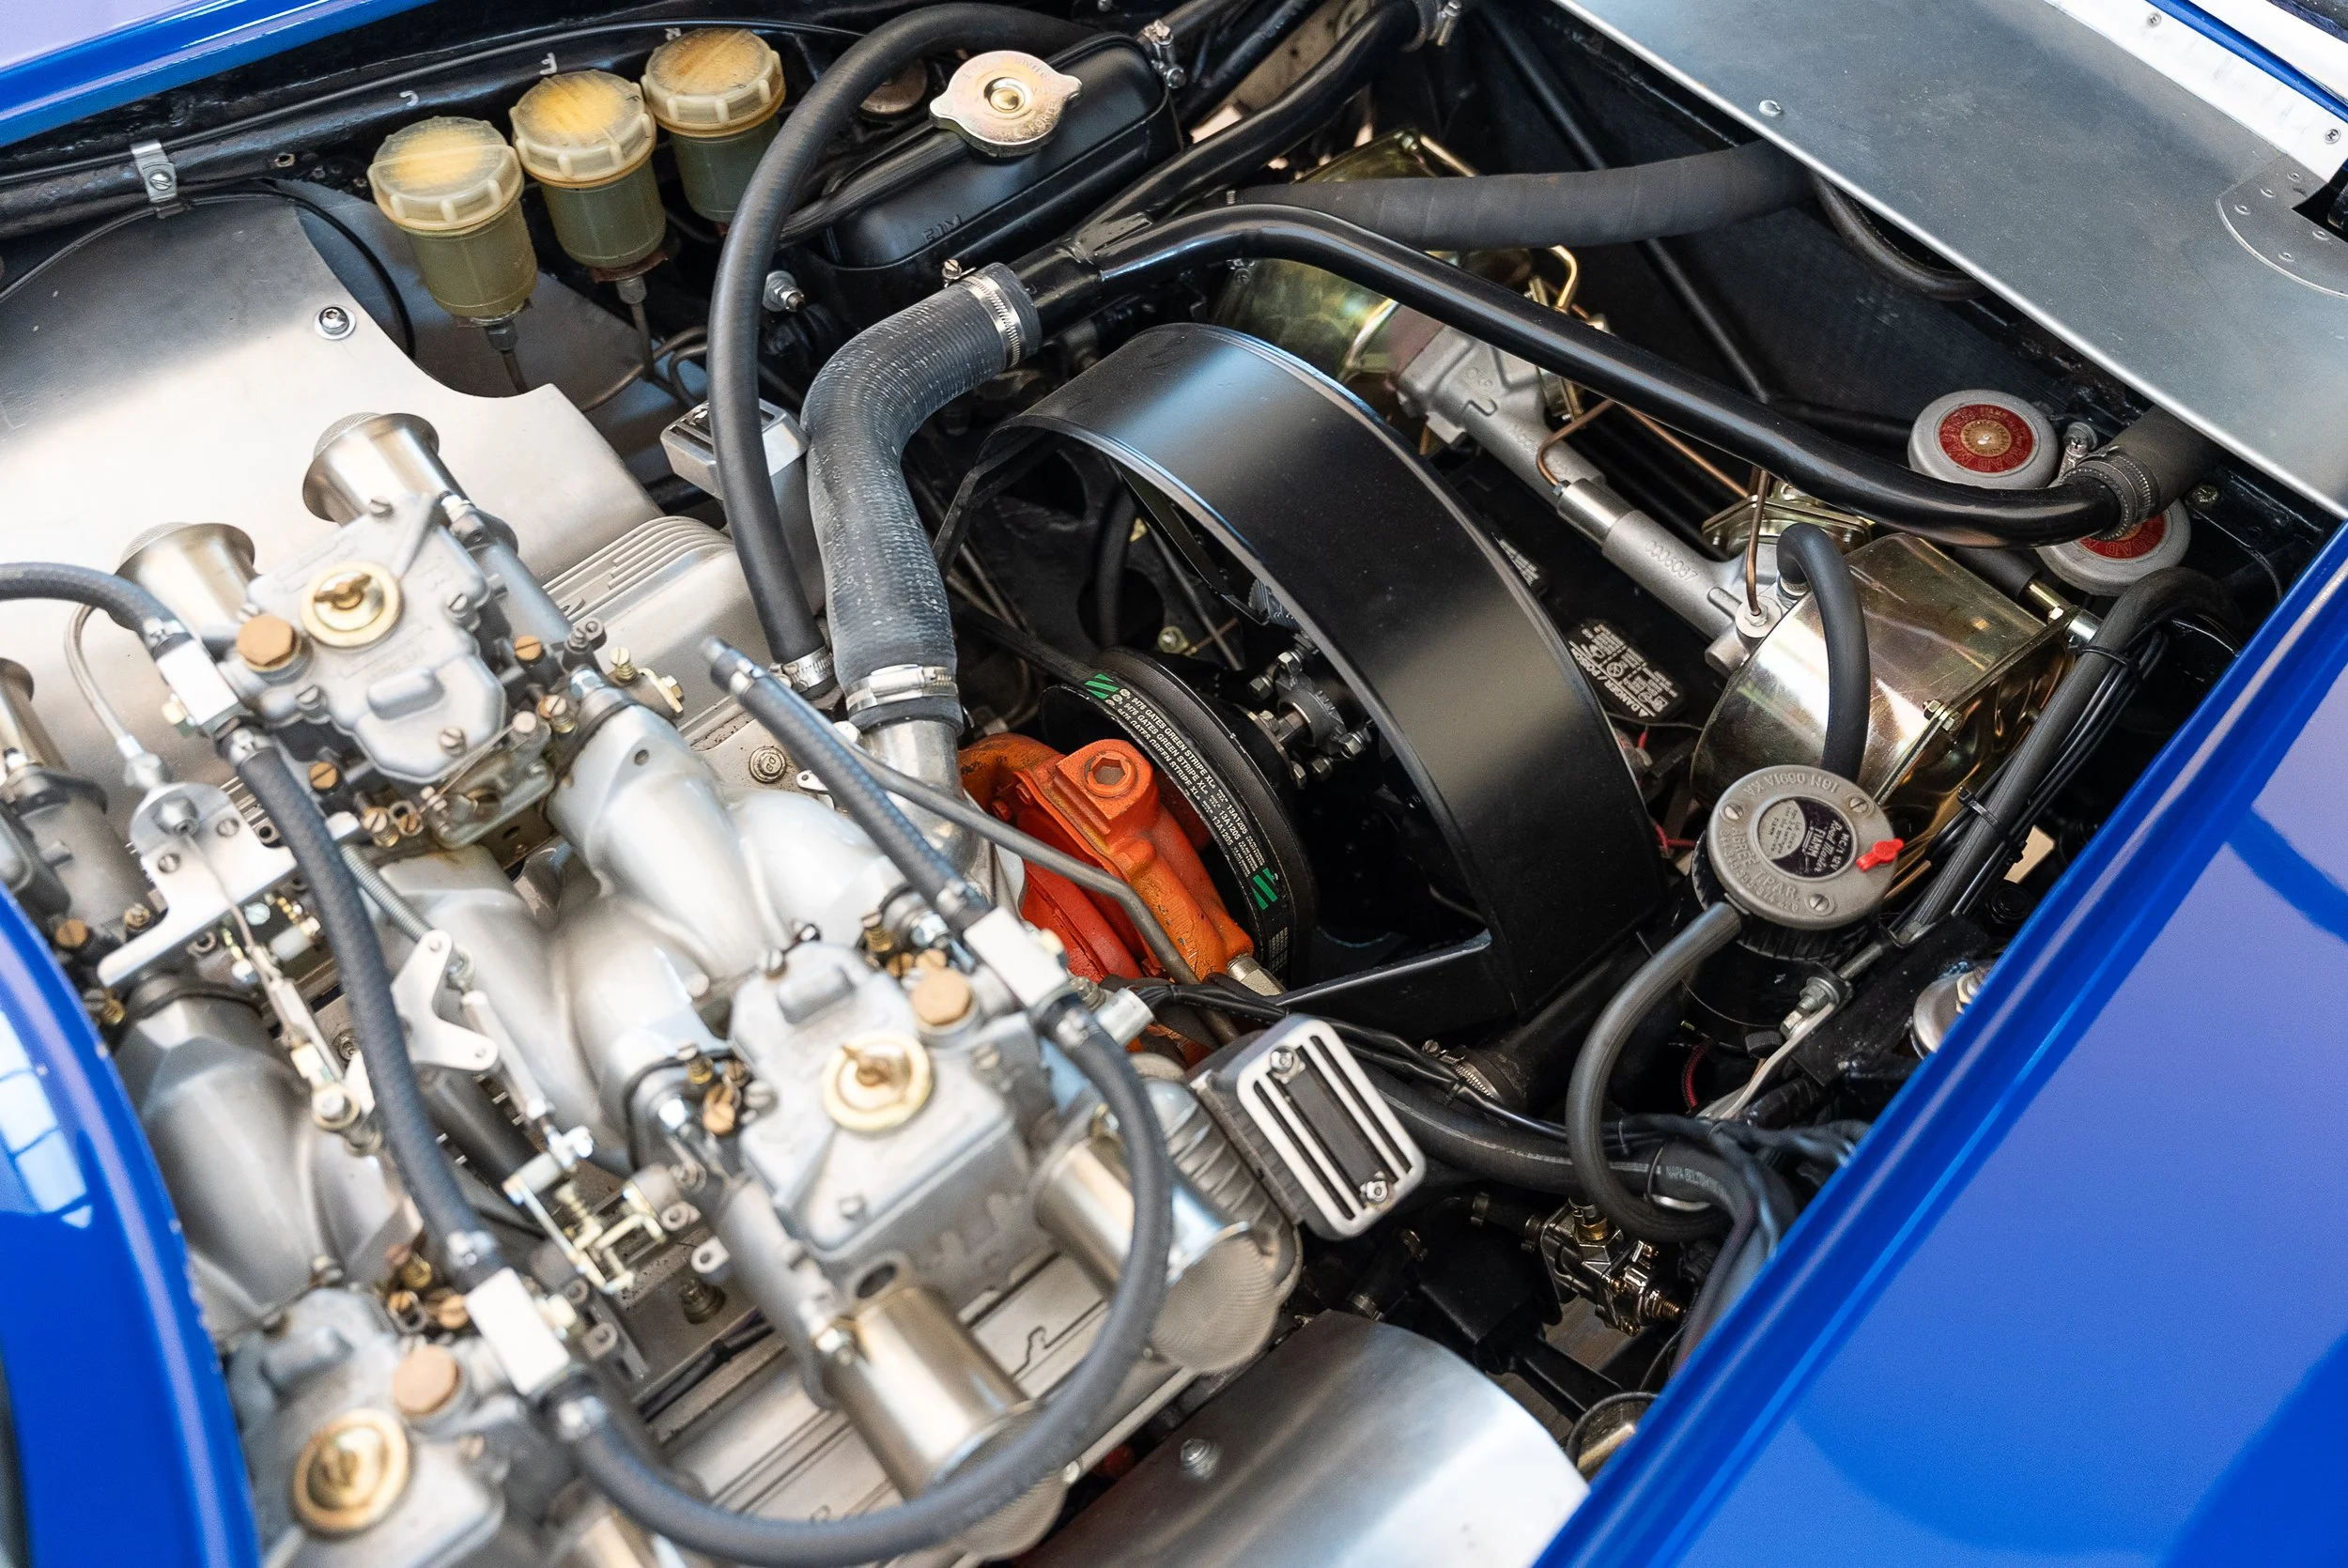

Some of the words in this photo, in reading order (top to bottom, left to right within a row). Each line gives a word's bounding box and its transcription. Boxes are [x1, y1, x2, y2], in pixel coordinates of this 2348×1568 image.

[539, 52, 560, 76] F
[1977, 446, 2029, 471] ROAD
[2105, 530, 2157, 556] ROAD
[1603, 681, 1641, 713] DANGER
[1136, 714, 1159, 735] GATES
[1155, 732, 1180, 757] GREEN
[1176, 755, 1200, 781] STRIPE
[1218, 809, 1241, 840] 13A1205
[1144, 709, 1166, 730] GATES
[1164, 728, 1187, 751] GREEN
[1183, 749, 1208, 776] STRIPE
[1226, 804, 1248, 835] 13A1205
[1743, 782, 1765, 796] KA
[1169, 761, 1192, 786] STRIPE
[1211, 816, 1234, 846] 13A1205
[1805, 827, 1826, 858] FIAMM
[1826, 820, 1843, 844] Road
[1813, 841, 1834, 875] Master
[1830, 853, 1841, 870] 12V
